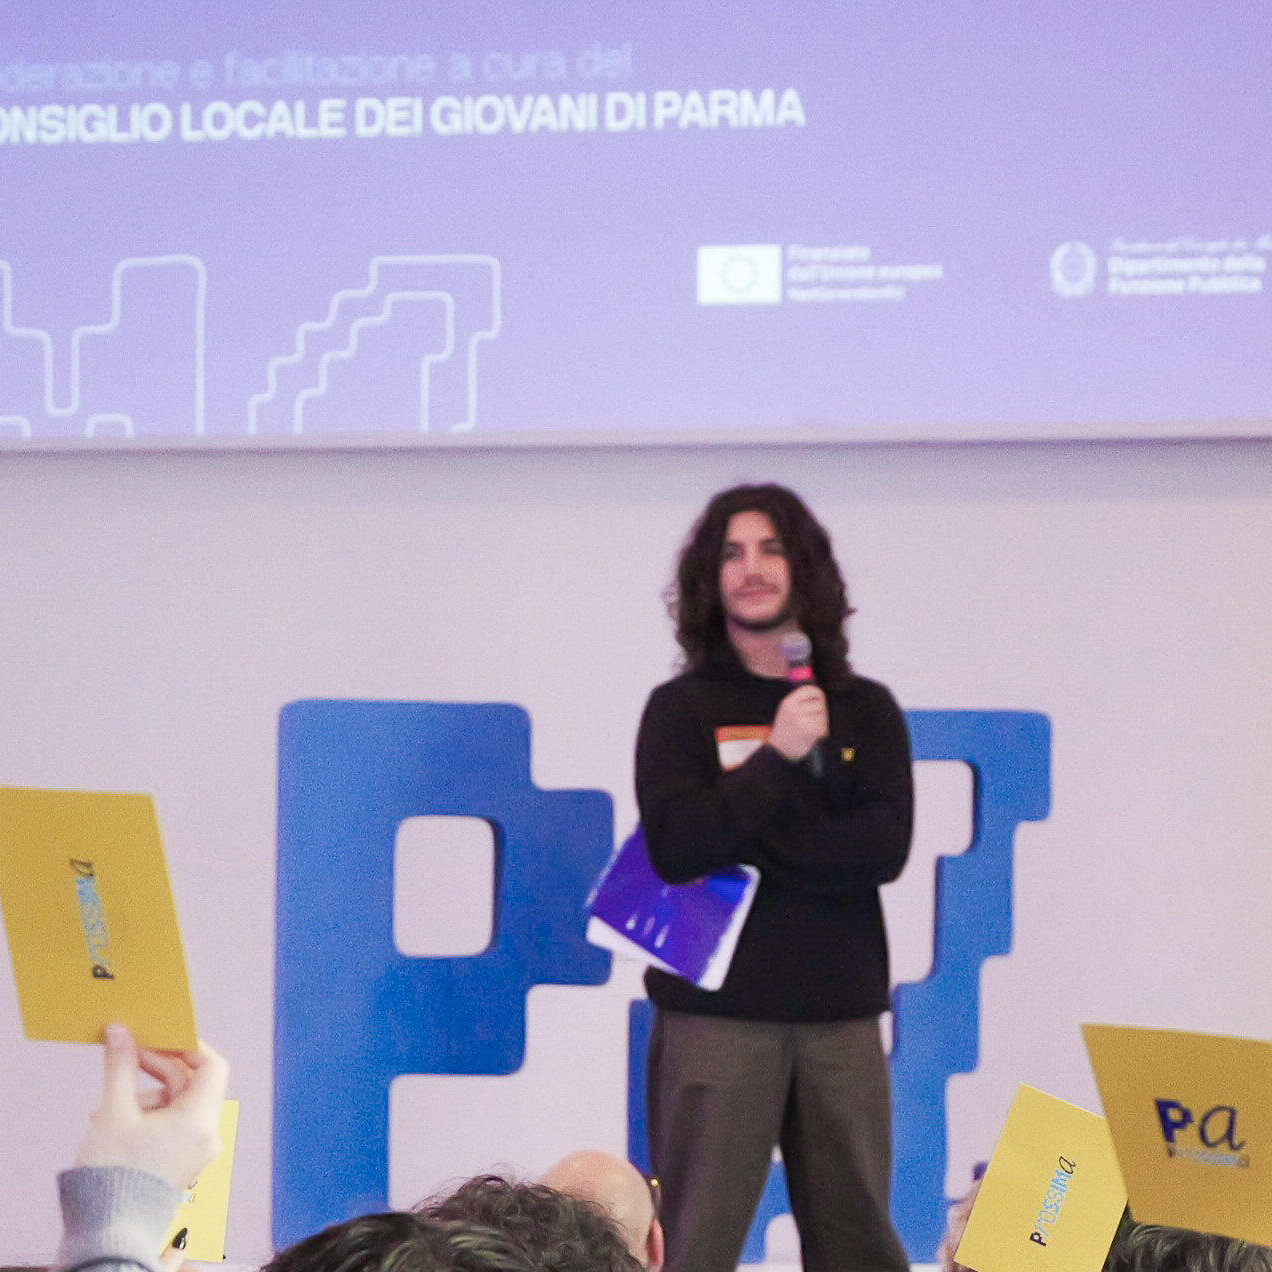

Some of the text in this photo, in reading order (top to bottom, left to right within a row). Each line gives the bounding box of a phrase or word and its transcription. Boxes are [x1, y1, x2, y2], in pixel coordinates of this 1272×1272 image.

[190, 60, 215, 88] e
[447, 52, 471, 82] a
[484, 51, 565, 81] cura
[180, 98, 347, 142] LOCALE
[355, 96, 423, 138] DEI
[430, 94, 598, 136] GIOVANI
[606, 91, 646, 132] DI
[653, 87, 807, 131] PARMA
